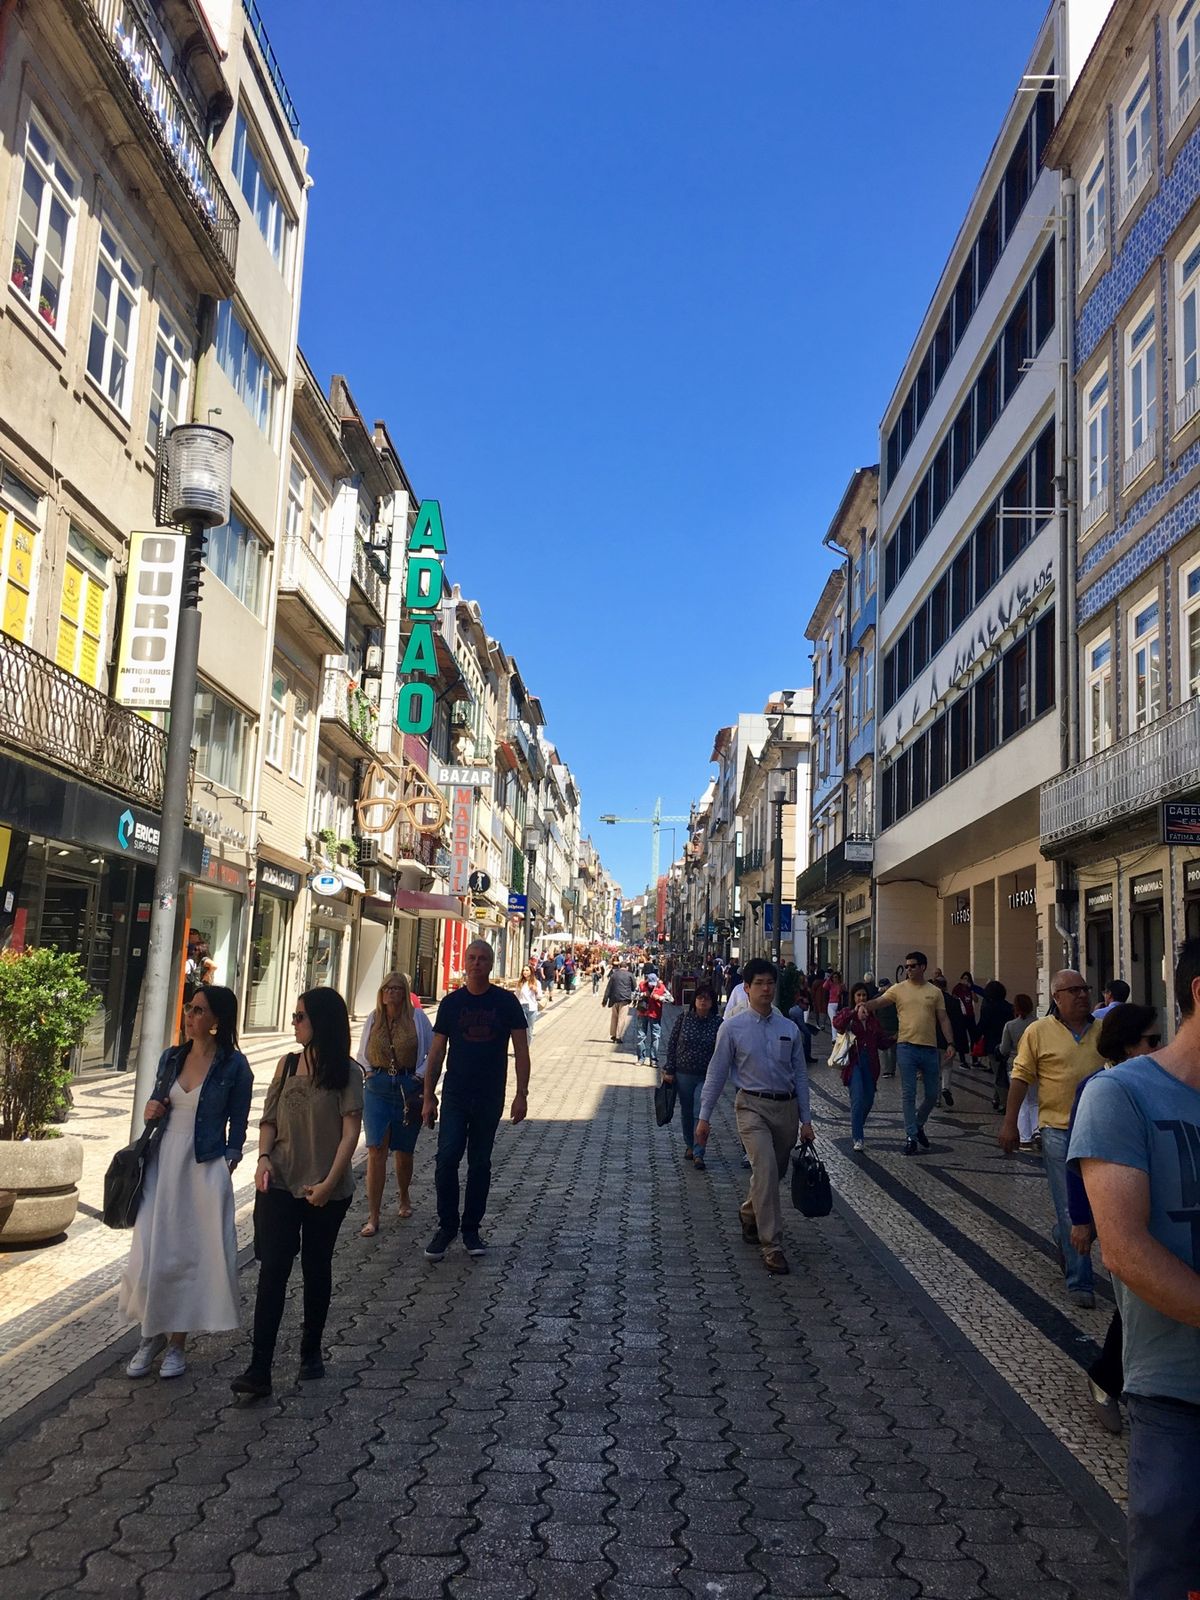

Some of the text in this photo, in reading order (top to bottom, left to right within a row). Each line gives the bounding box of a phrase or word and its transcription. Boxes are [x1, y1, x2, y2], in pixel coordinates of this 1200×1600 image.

[131, 537, 176, 662] OURO
[397, 499, 447, 735] ADÃO
[439, 768, 491, 785] BAZAR
[135, 822, 160, 846] ERICEI
[452, 788, 472, 892] MABRIL
[1134, 880, 1164, 895] PRONOVIAS
[951, 908, 970, 926] TIFFOS
